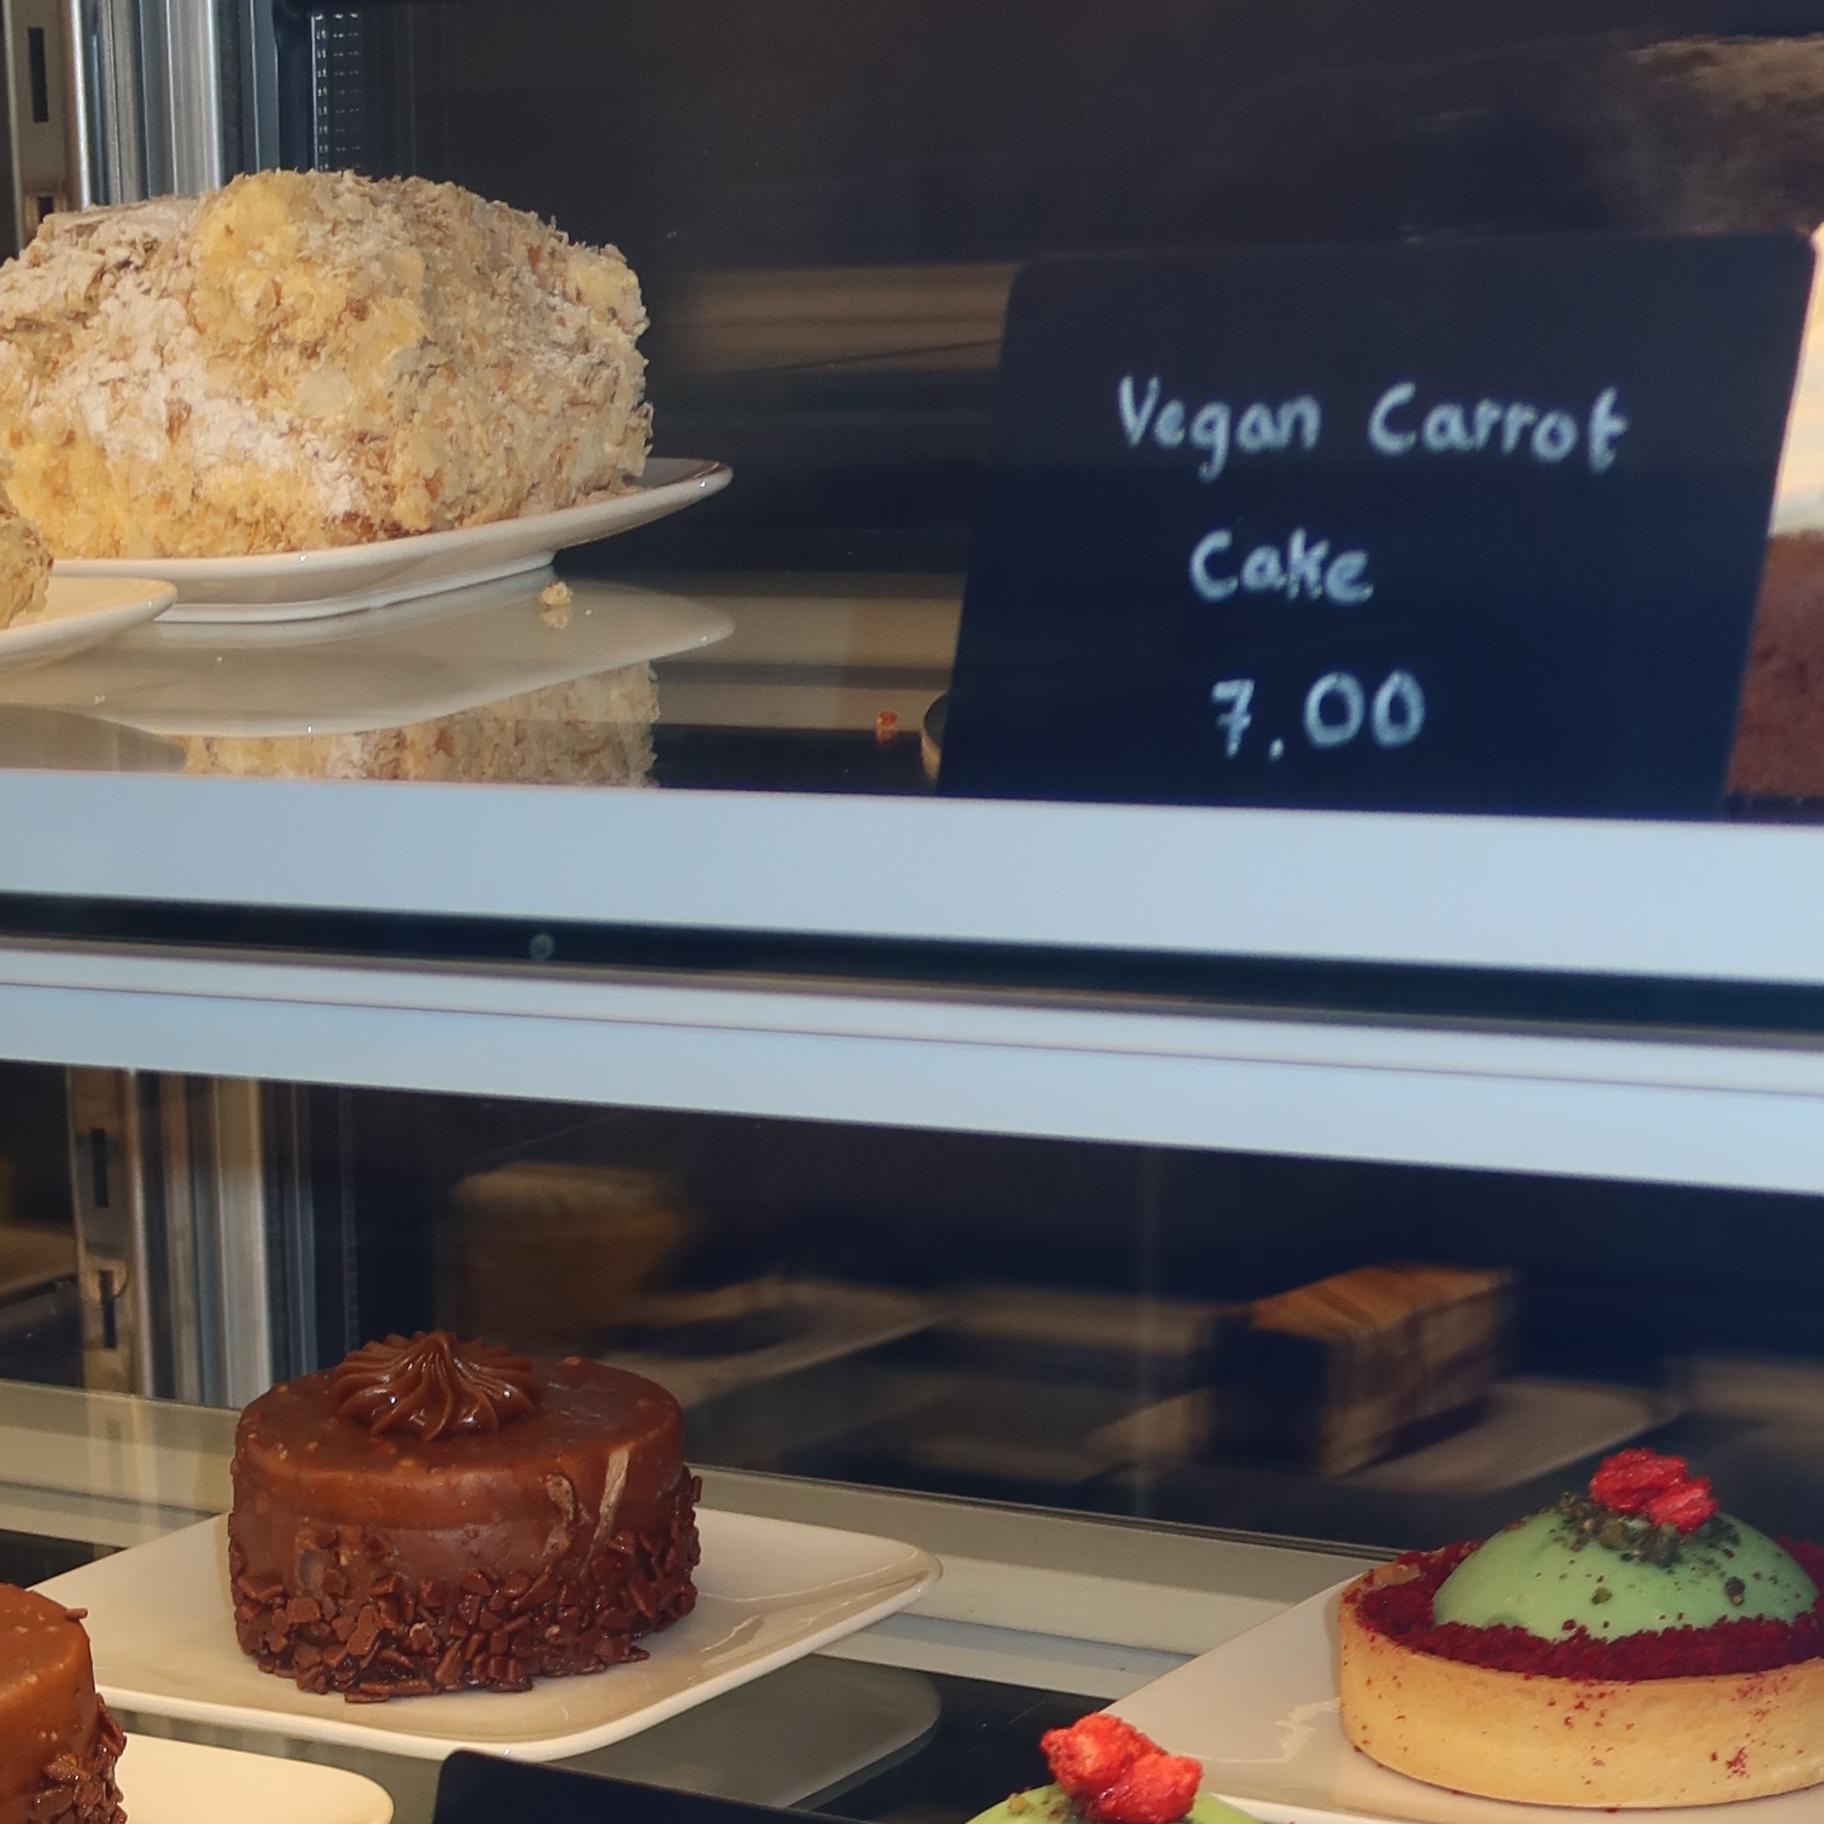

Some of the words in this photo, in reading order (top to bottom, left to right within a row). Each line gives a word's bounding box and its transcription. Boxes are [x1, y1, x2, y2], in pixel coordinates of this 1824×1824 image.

[1118, 377, 1321, 480] Vegan
[1369, 382, 1629, 474] Carrot
[1191, 529, 1374, 604] Cake
[1212, 669, 1426, 759] 7.00
